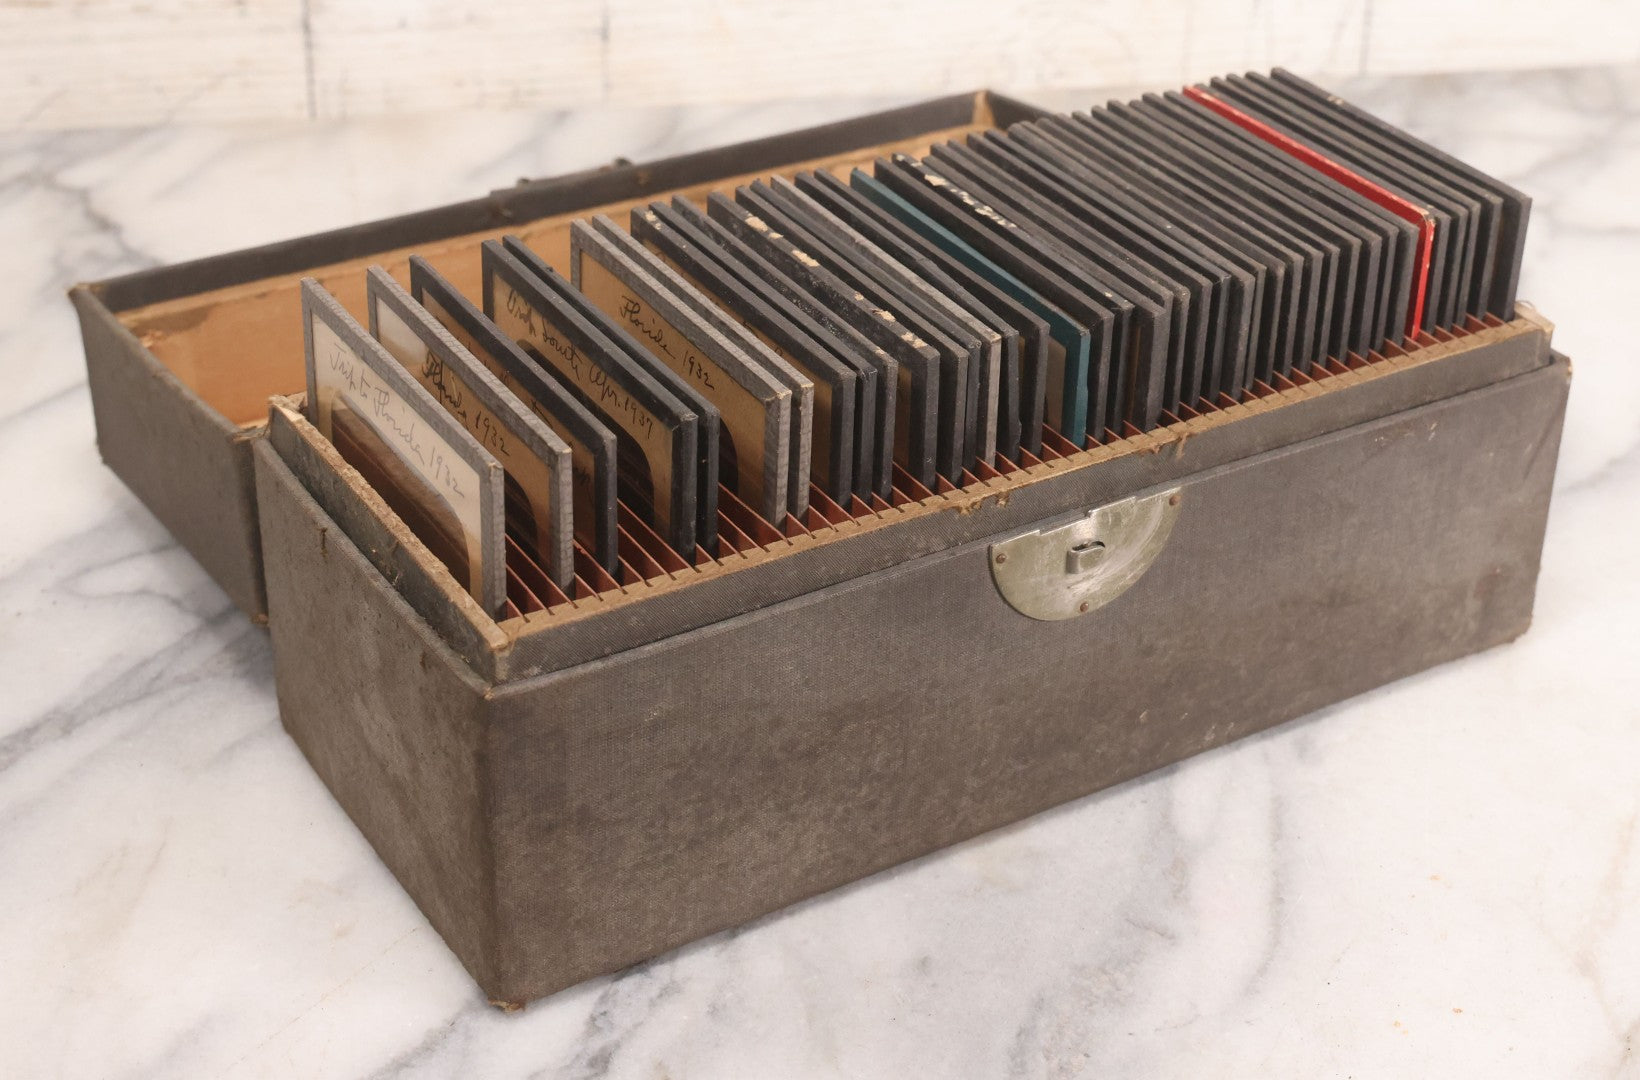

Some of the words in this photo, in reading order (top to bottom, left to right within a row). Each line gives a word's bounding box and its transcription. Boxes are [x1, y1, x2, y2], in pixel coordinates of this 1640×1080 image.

[682, 350, 715, 391] 1932
[360, 369, 372, 399] to
[373, 387, 425, 465] Florida
[430, 445, 465, 498] 1932
[474, 410, 511, 457] 1932
[625, 401, 654, 439] 1937
